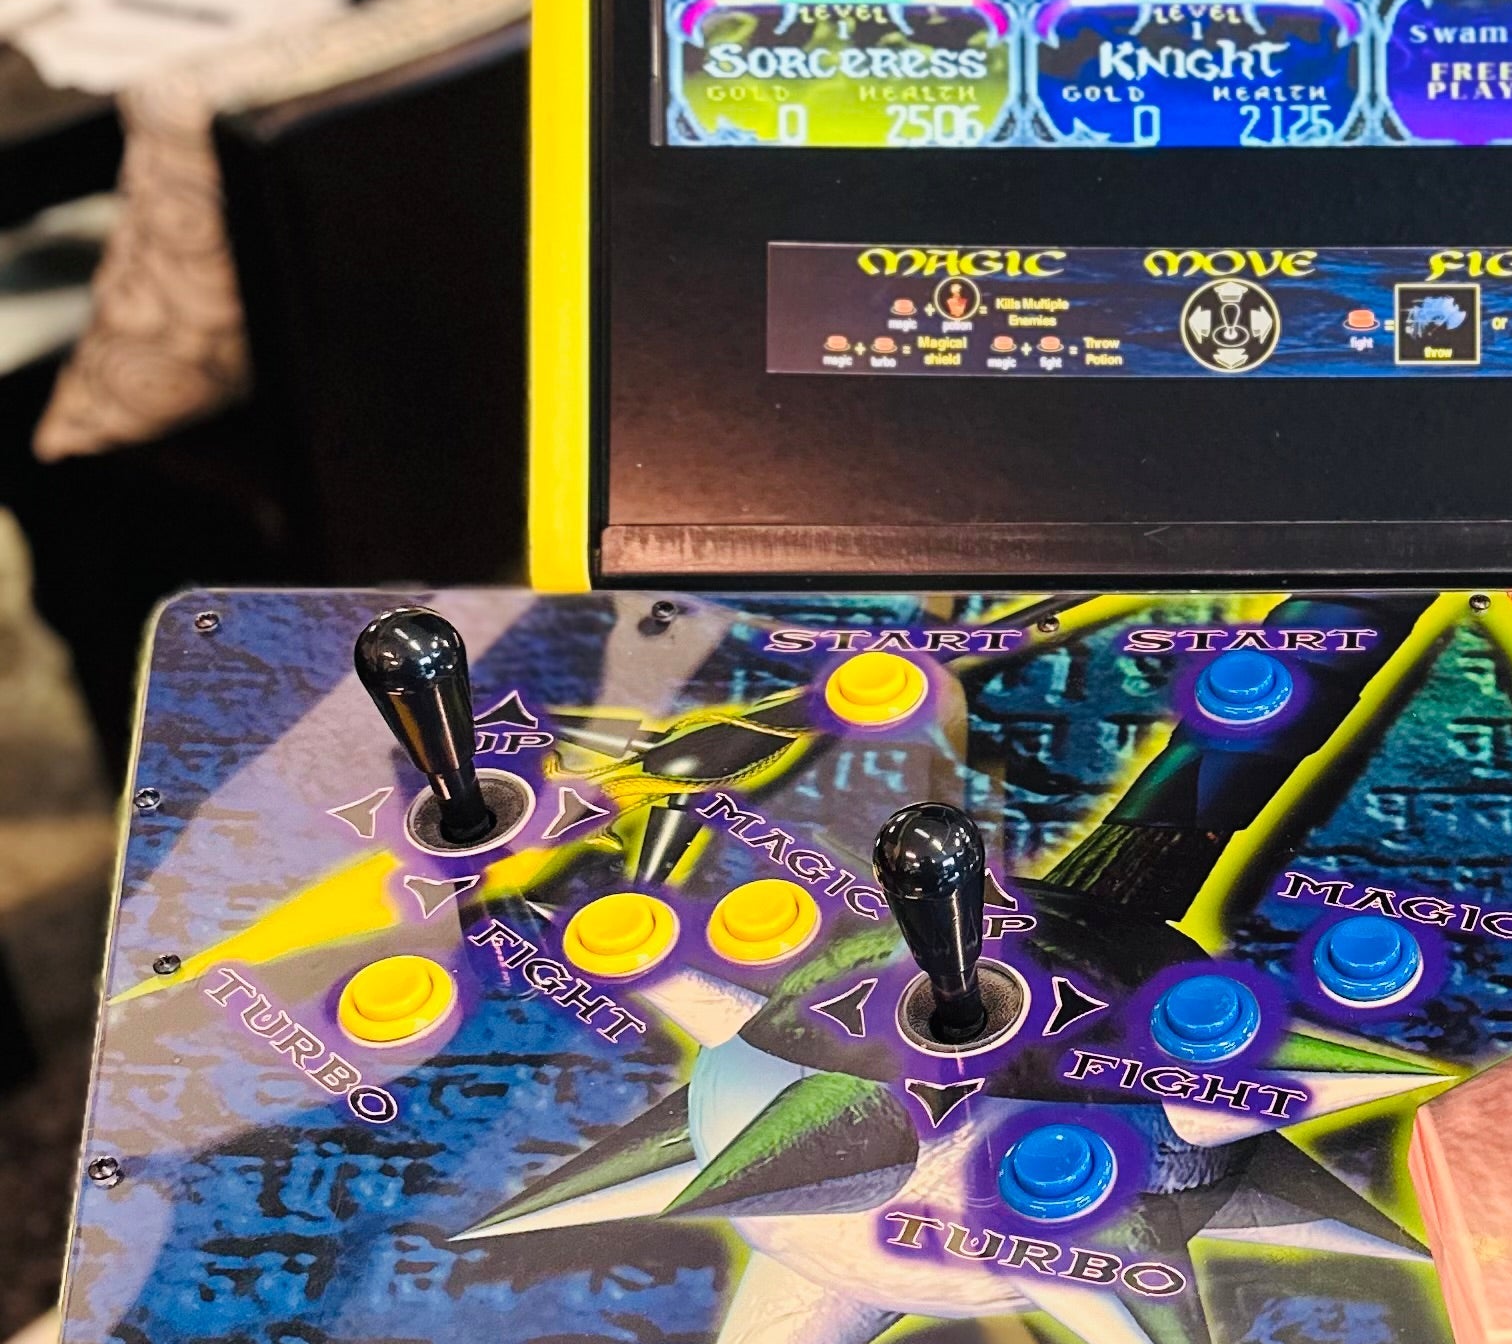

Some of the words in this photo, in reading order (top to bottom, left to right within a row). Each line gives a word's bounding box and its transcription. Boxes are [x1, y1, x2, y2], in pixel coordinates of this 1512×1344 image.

[706, 86, 790, 102] GOLD
[859, 86, 976, 102] HEALTH
[1062, 85, 1145, 102] GOLD
[1213, 85, 1327, 102] HEALTH
[777, 104, 806, 143] 0
[886, 104, 983, 144] 2506
[1133, 105, 1160, 146] 0
[857, 248, 1066, 278] MAGIC
[1144, 249, 1317, 278] MOVE
[995, 298, 1021, 310] Kills
[1022, 298, 1070, 312] Multiple
[887, 318, 918, 332] magic
[941, 320, 973, 333] potion
[1008, 314, 1057, 326] Enemies
[1491, 316, 1508, 330] or
[917, 336, 967, 351] Magical
[1083, 337, 1120, 349] Throw
[1350, 337, 1374, 351] fight
[924, 353, 961, 366] shield
[1085, 354, 1123, 366] Potion
[1424, 346, 1453, 359] throw
[822, 355, 853, 368] magic
[870, 356, 896, 368] turbo
[987, 357, 1017, 370] magic
[1039, 356, 1062, 370] fight
[765, 629, 1022, 652] START
[1124, 628, 1380, 652] START
[697, 792, 888, 920] MAGIC
[467, 919, 647, 1044] FIGHT
[203, 968, 398, 1125] TURBO
[1064, 1050, 1308, 1121] FIGHT
[885, 1211, 1188, 1299] TURBO
